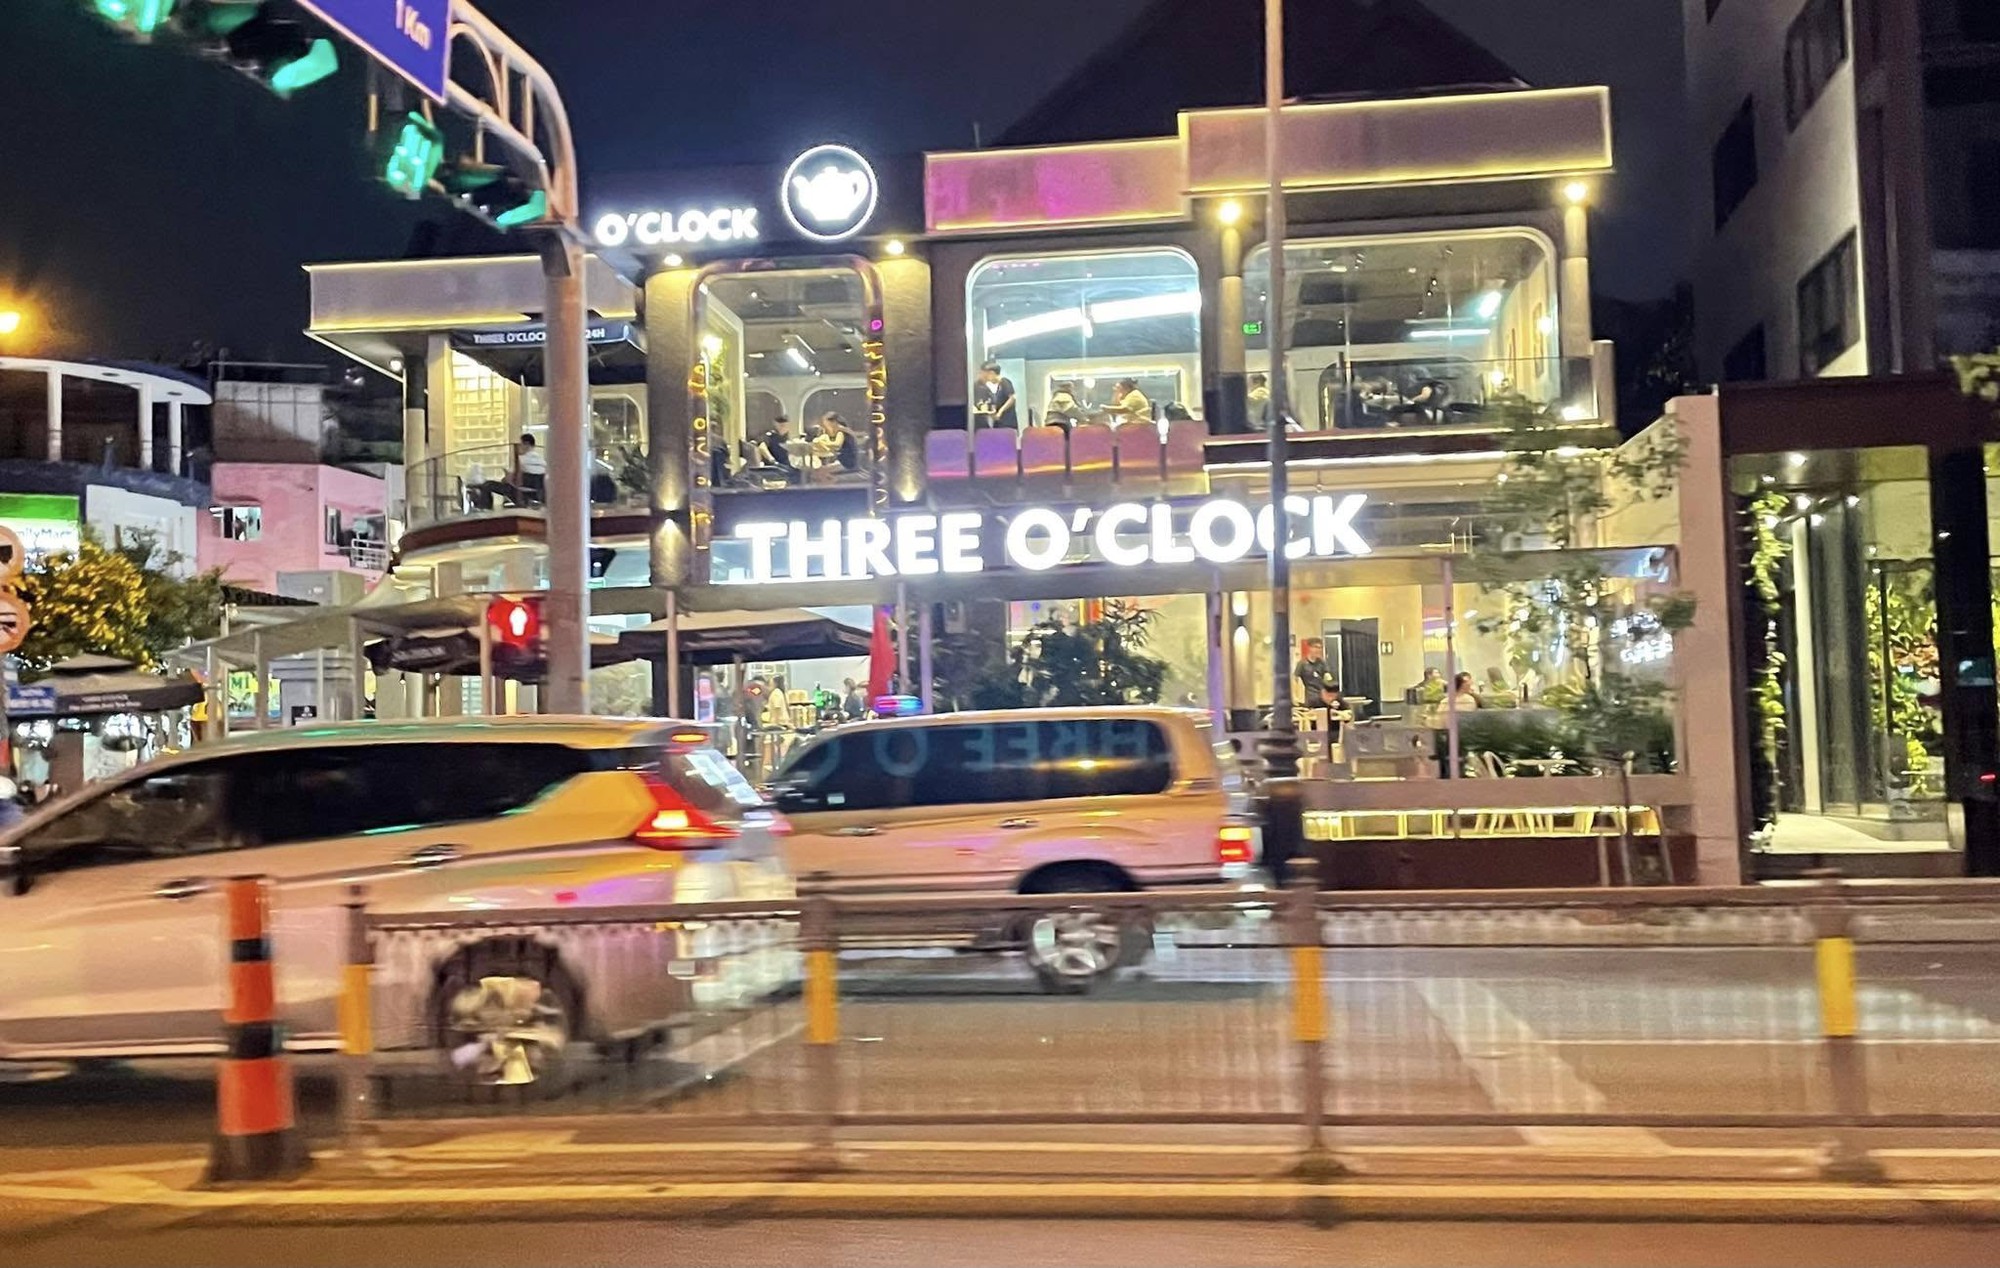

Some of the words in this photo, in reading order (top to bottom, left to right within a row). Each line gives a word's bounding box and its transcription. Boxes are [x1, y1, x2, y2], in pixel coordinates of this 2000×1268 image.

[596, 208, 758, 246] O'CLOCK
[735, 513, 984, 581] THREE
[1007, 494, 1371, 570] O'CLOCK
